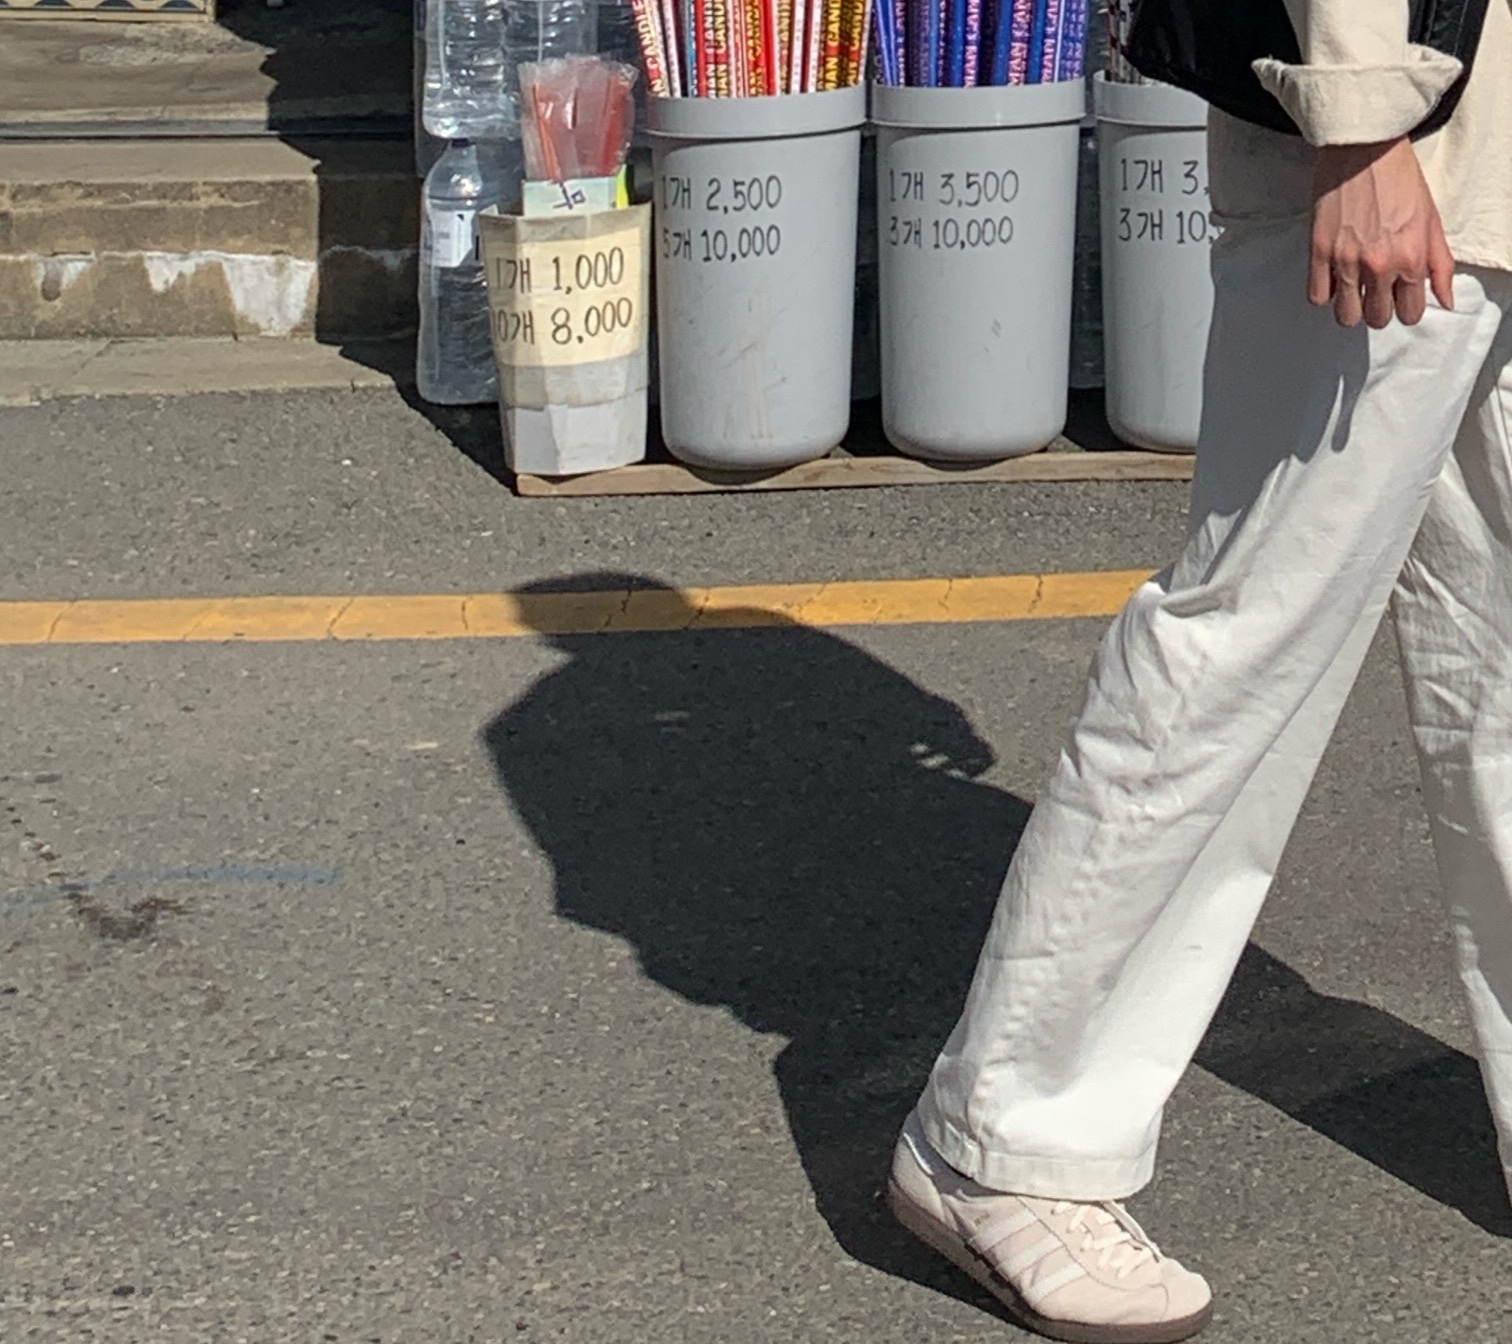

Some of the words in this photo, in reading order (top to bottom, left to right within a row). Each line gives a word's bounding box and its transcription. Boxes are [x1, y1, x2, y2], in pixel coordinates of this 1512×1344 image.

[706, 175, 783, 218] 2,500
[889, 169, 925, 204] 1개
[939, 168, 1020, 210] 3,500
[1120, 158, 1164, 195] 1개
[700, 224, 783, 264] 10,000
[889, 216, 924, 250] 3개
[931, 215, 1015, 251] 10,000
[1118, 208, 1165, 243] 3개
[551, 247, 626, 295] 1,000
[551, 297, 633, 346] 8,000
